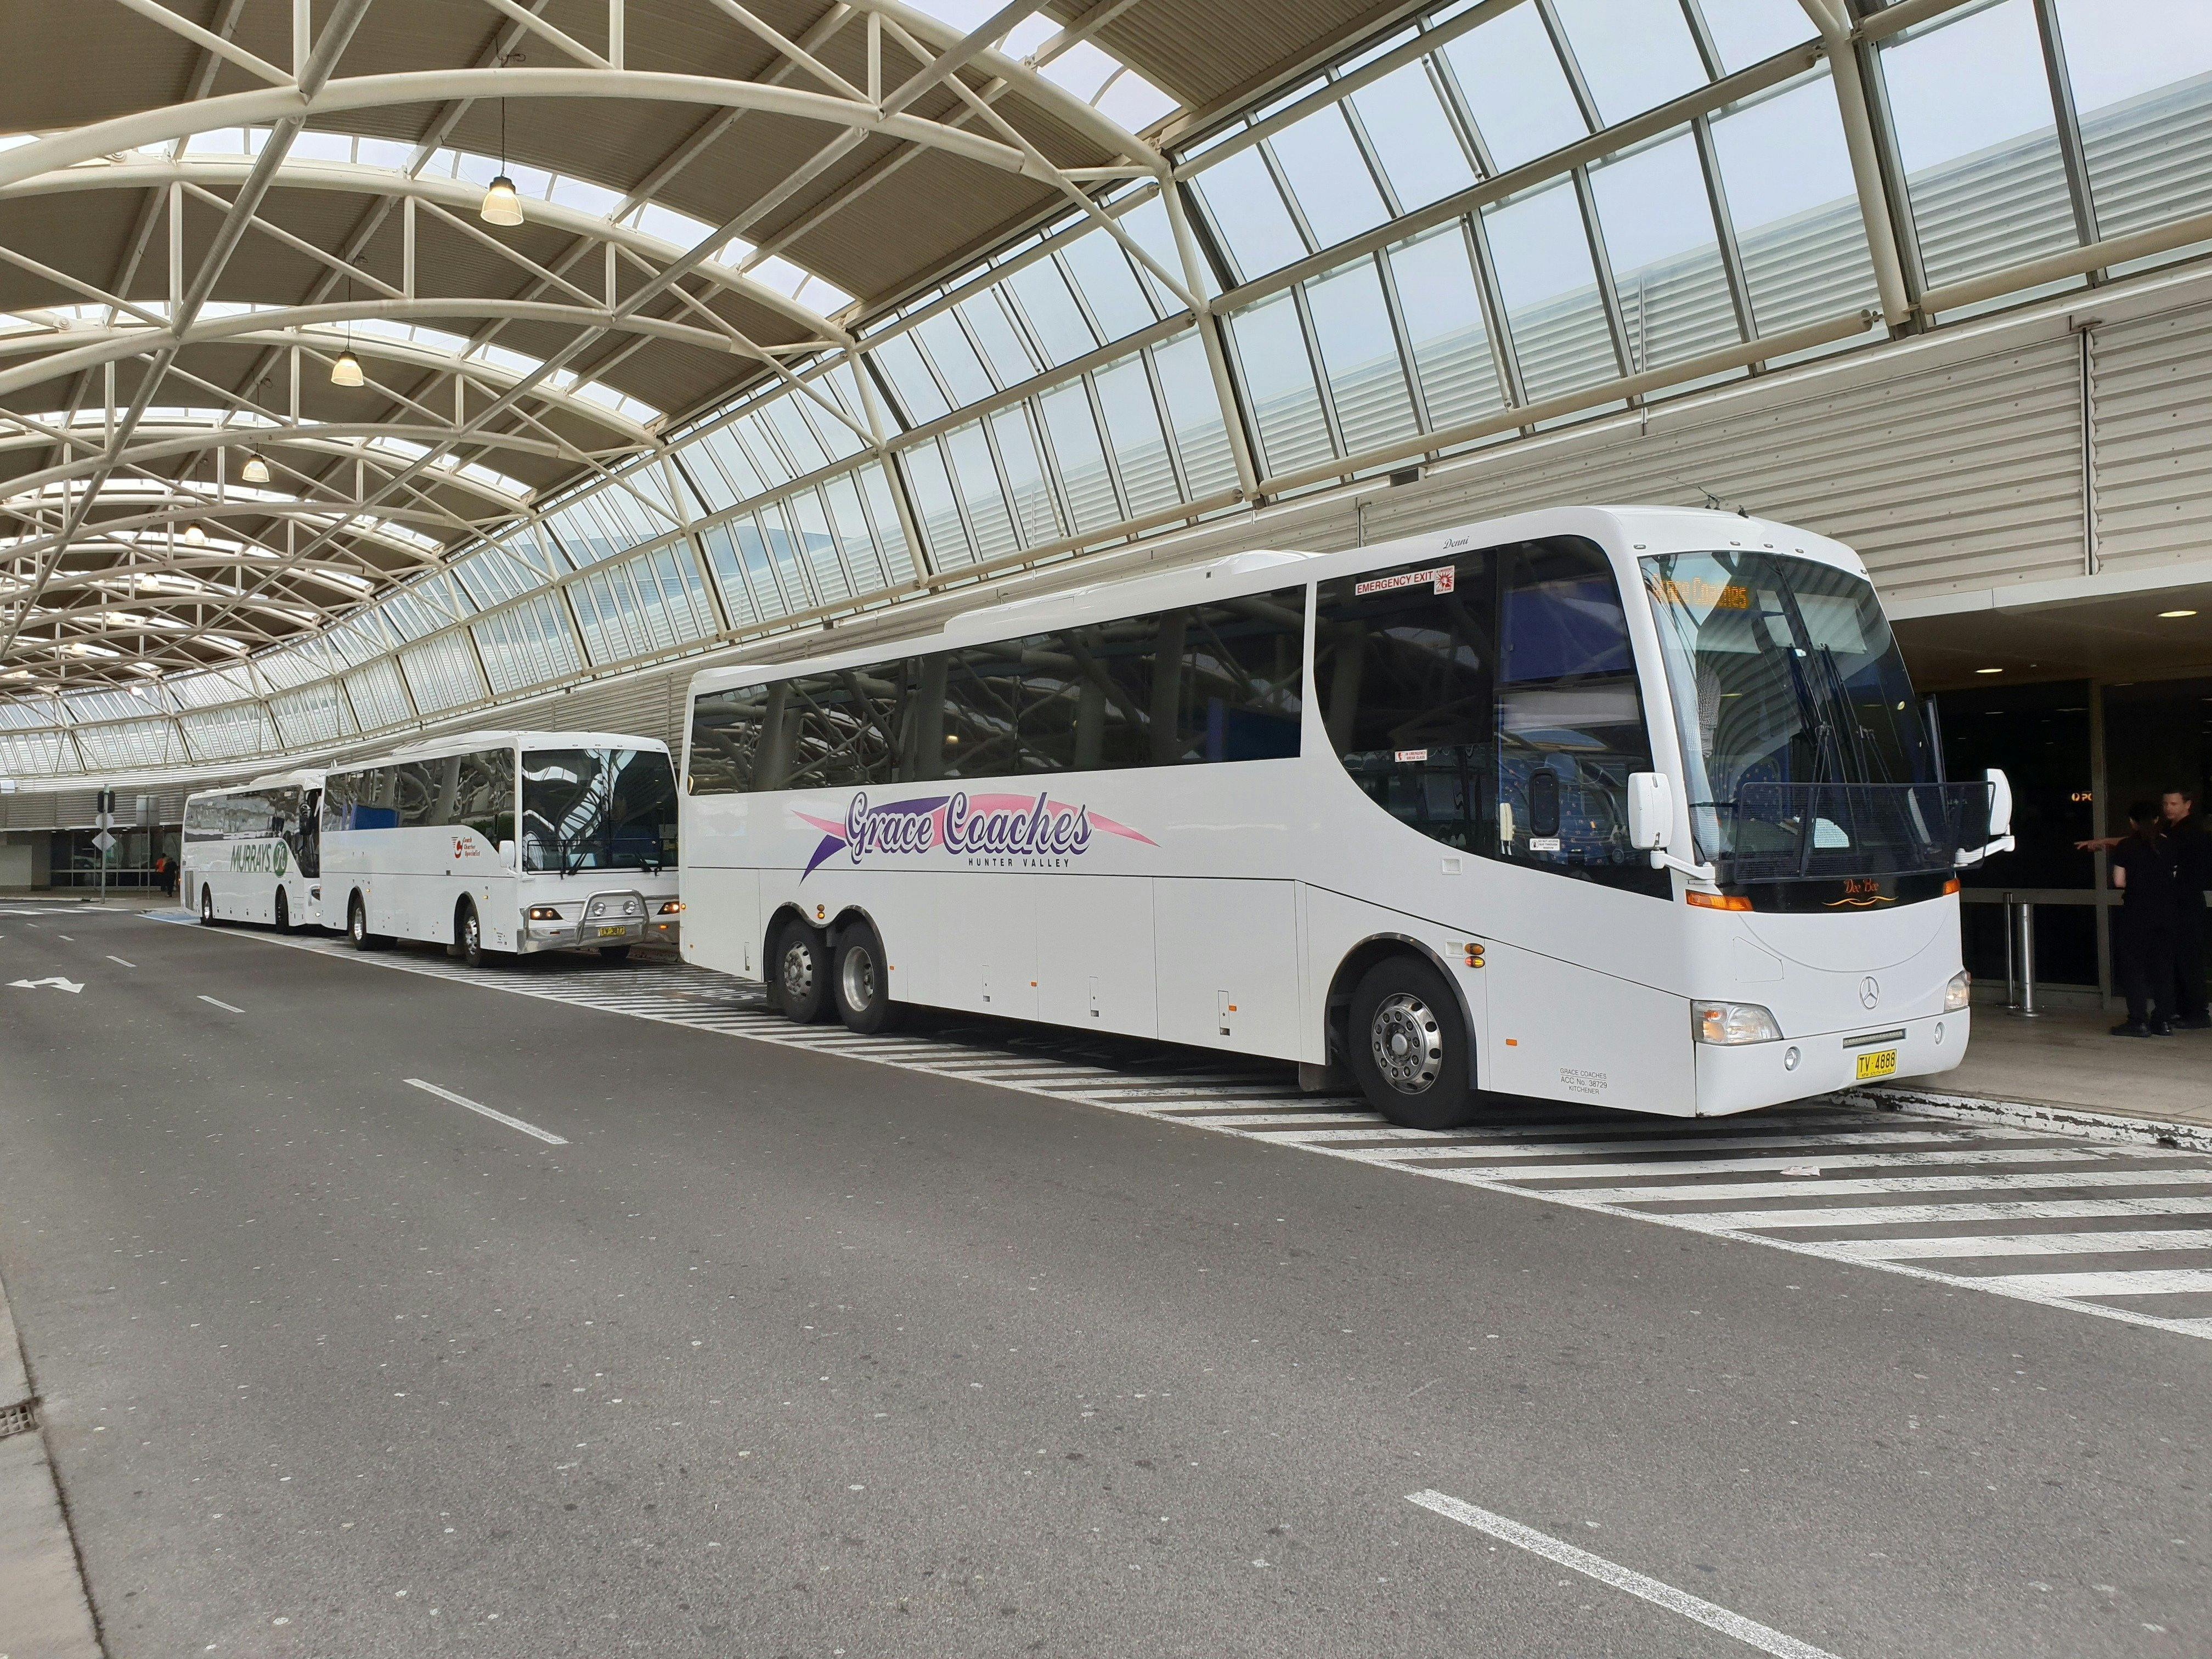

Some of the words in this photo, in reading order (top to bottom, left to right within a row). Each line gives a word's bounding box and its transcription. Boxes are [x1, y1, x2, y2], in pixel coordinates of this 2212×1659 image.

[1357, 575, 1412, 594] EMERGENCY
[1414, 571, 1434, 583] EXIT
[845, 791, 933, 865] Grace
[943, 792, 1091, 855] Coaches
[230, 843, 272, 872] MURRAYS
[968, 858, 1013, 867] HUNTER
[1023, 859, 1069, 867] VALLEY
[1875, 1052, 1895, 1070] 4888
[1580, 1070, 1606, 1079] COACHES
[1568, 1085, 1599, 1094] KITCHENER
[1589, 1080, 1607, 1088] 38729
